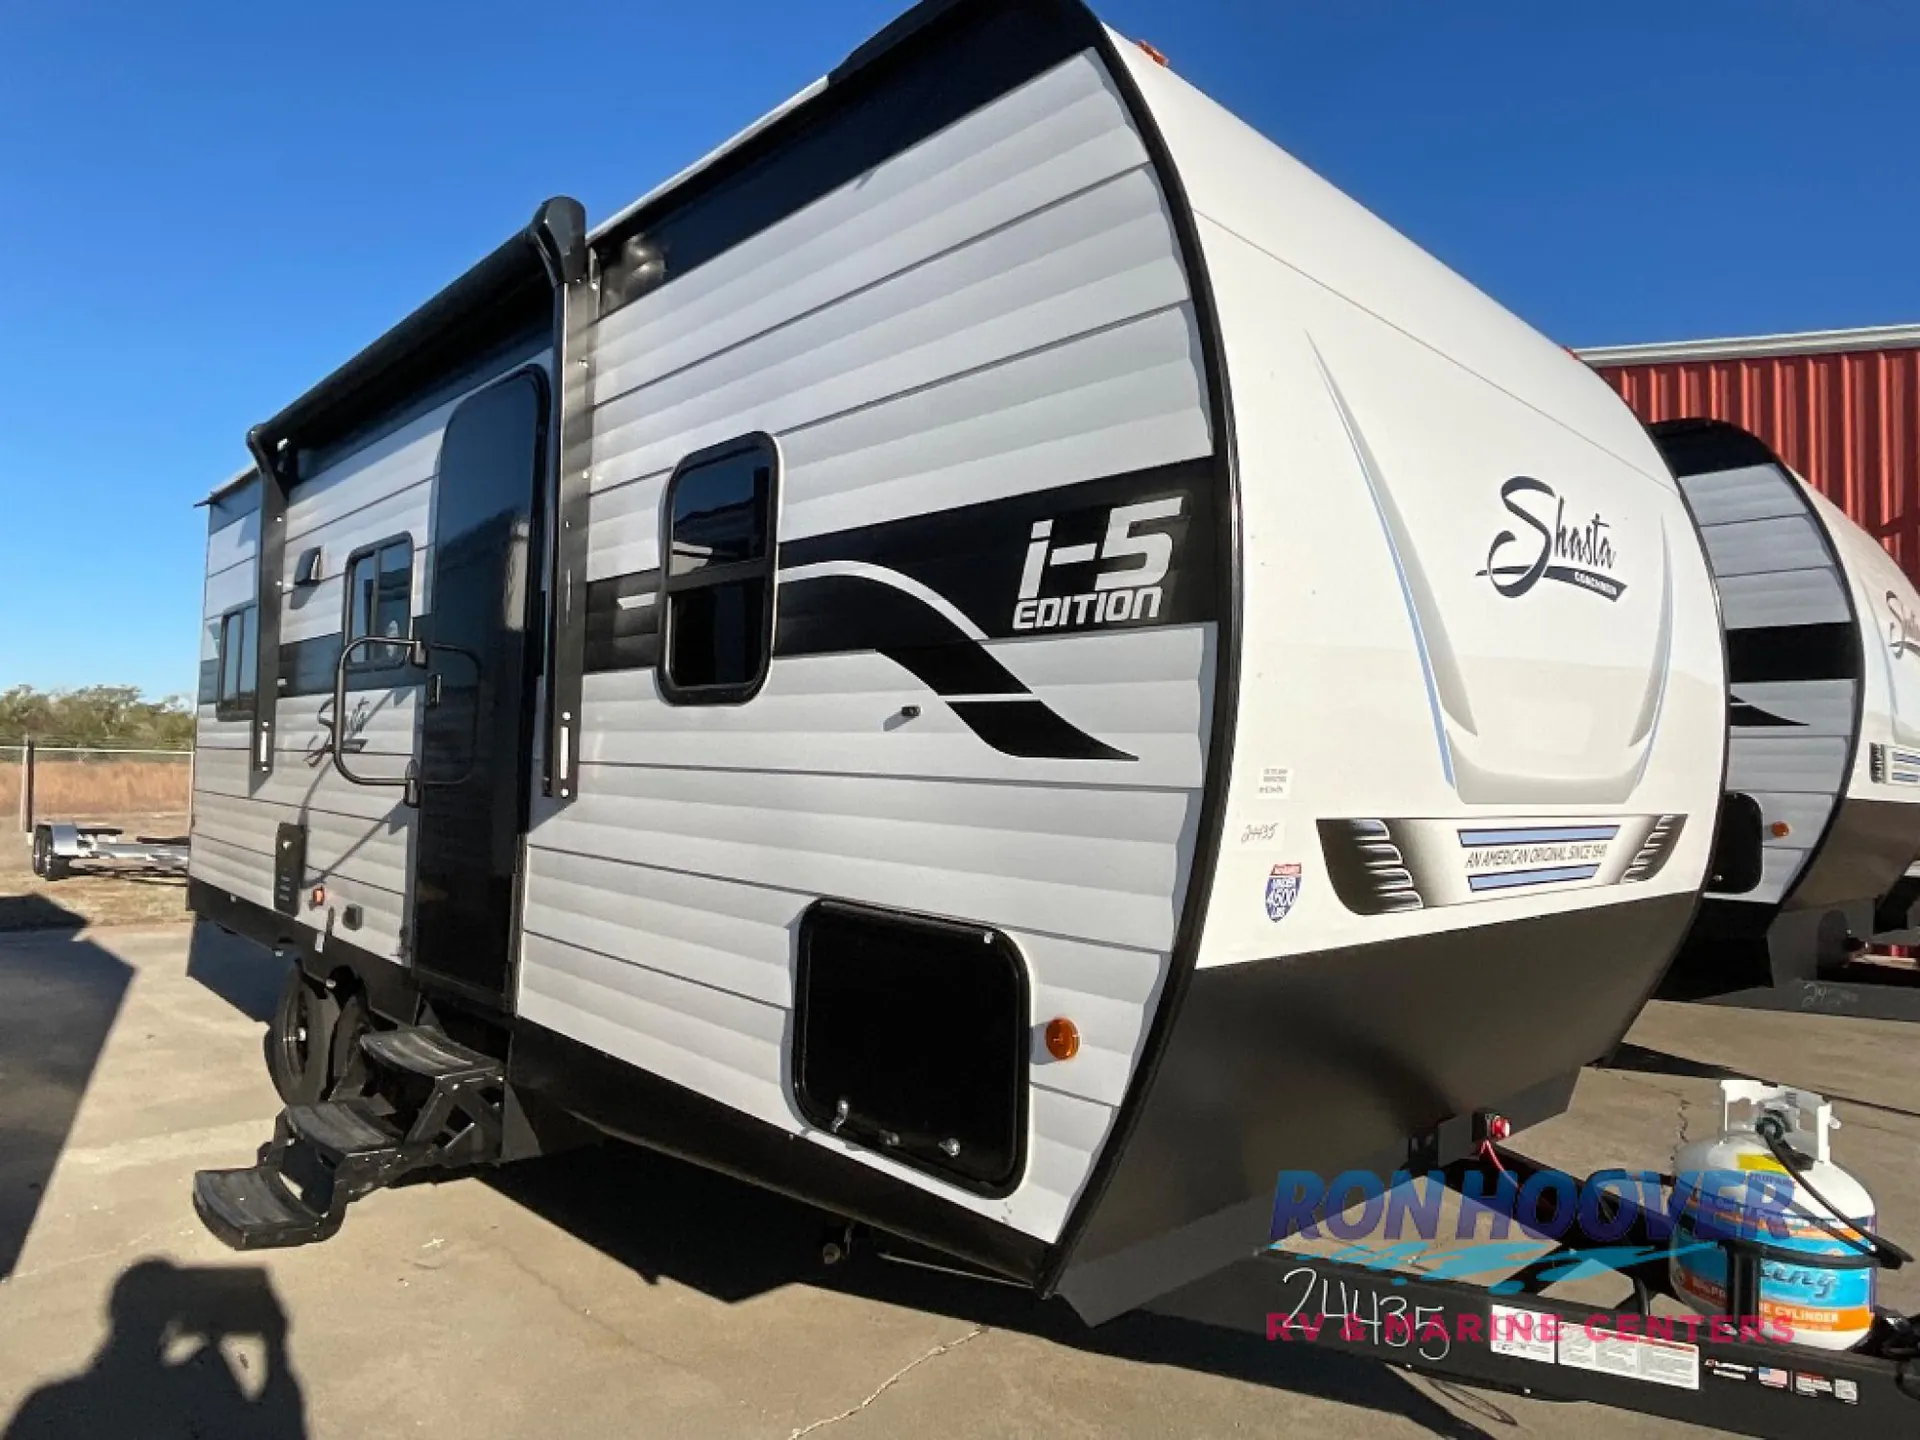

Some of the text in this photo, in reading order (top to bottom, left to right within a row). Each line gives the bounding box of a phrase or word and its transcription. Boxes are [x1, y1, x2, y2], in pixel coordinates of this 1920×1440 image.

[1018, 496, 1183, 600] i-5
[1487, 476, 1616, 598] Shasta
[1012, 586, 1163, 630] EDITION
[1464, 850, 1481, 868] AN
[1481, 848, 1528, 866] AMERICAN
[1530, 846, 1566, 863] ORIGINAL
[1282, 1267, 1451, 1360] 24435
